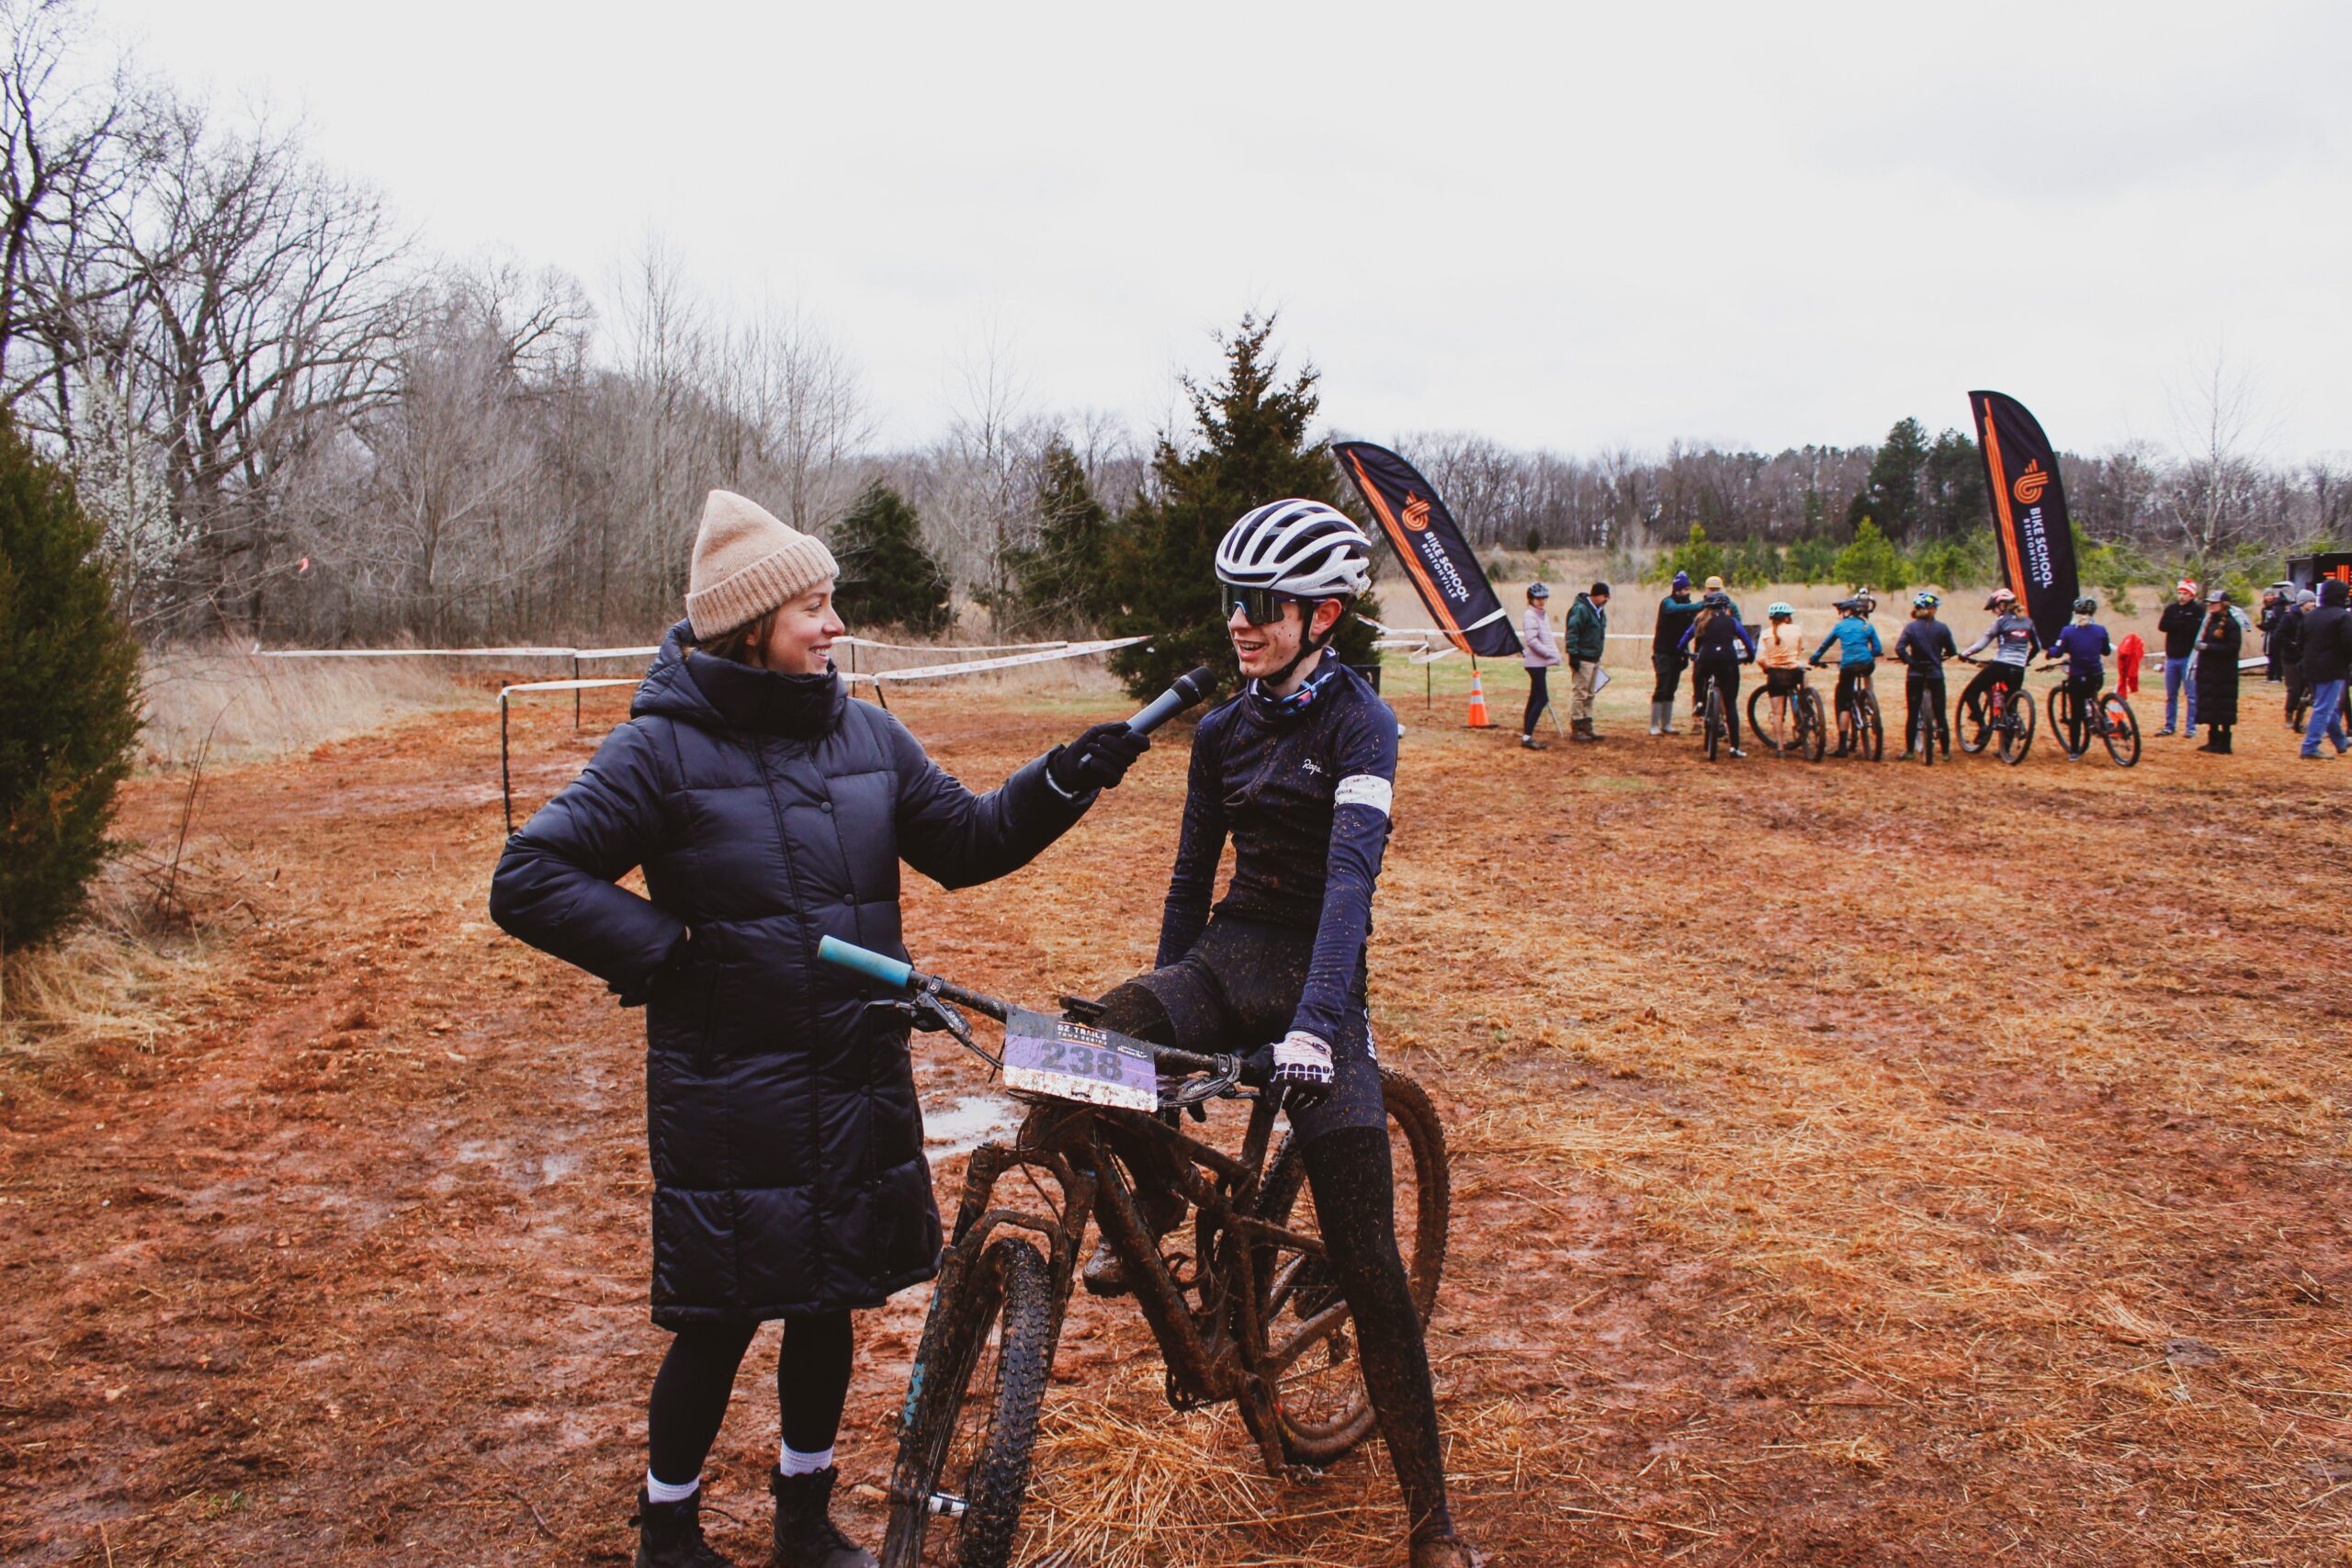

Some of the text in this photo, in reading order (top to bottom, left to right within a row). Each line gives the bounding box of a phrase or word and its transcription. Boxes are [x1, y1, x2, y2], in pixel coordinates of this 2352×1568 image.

[1421, 543, 1458, 599] BENTONVILLE
[1424, 531, 1470, 603] BIKE SCHOOL
[2023, 518, 2041, 582] BENTONVILLE
[2030, 506, 2053, 589] BIKE SCHOOL
[1040, 1042, 1123, 1081] 238
[1073, 1026, 1107, 1041] TRAILS
